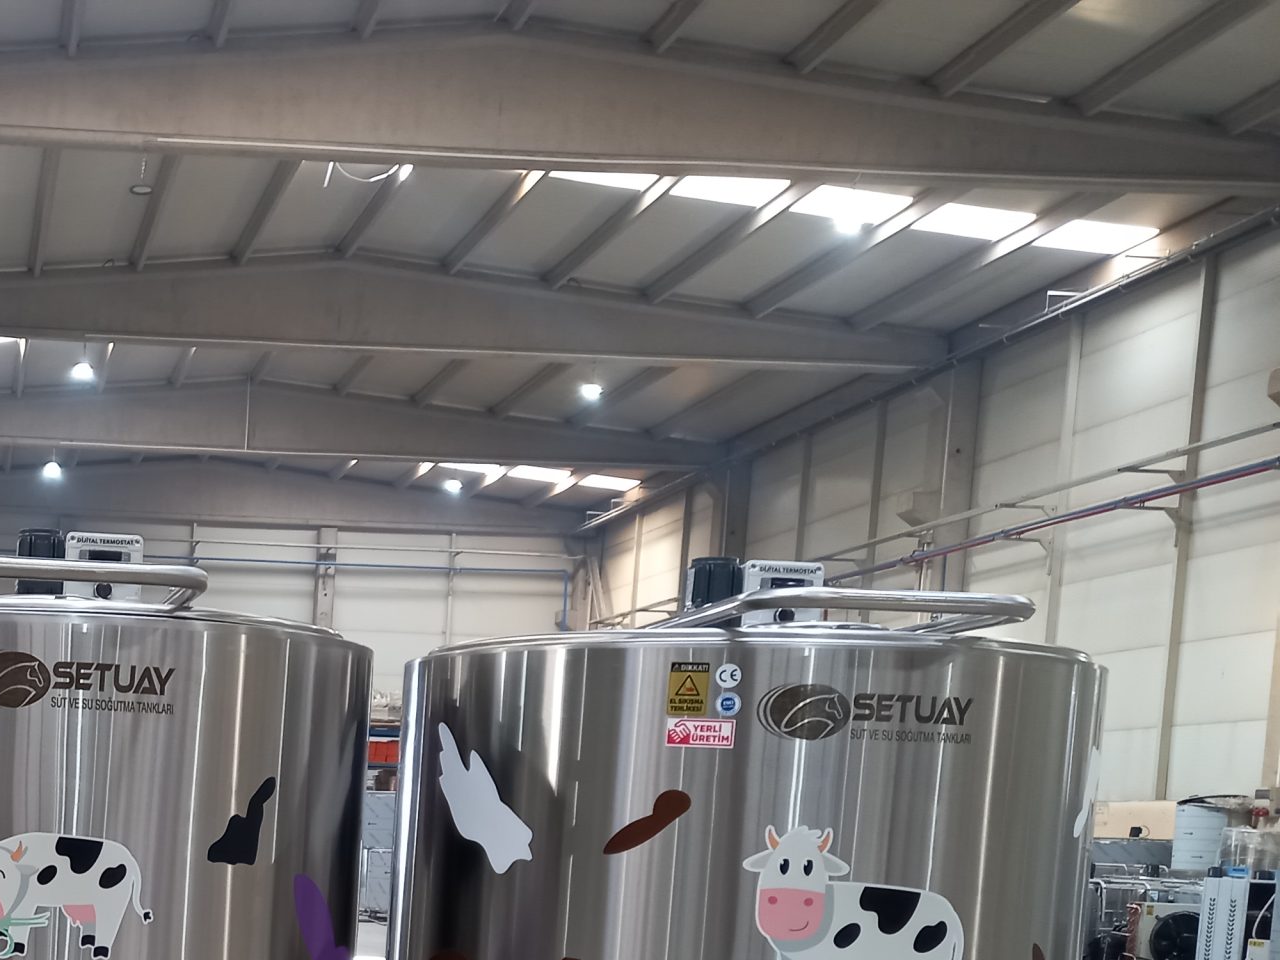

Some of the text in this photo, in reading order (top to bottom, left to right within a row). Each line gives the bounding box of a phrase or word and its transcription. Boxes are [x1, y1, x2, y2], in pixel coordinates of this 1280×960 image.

[99, 538, 134, 546] TERMOSTAT
[782, 567, 817, 575] TERMOSTAT
[52, 661, 176, 696] SETUAY
[719, 668, 739, 683] CE
[50, 693, 174, 715] SÜT VE SU SOĞUTMA TANKLARI
[852, 692, 974, 726] SETUAY
[692, 723, 722, 733] YERLİ
[691, 733, 730, 744] ÜRETİM
[869, 728, 880, 741] VE
[882, 728, 893, 741] SU
[937, 731, 972, 745] TANKLARI
